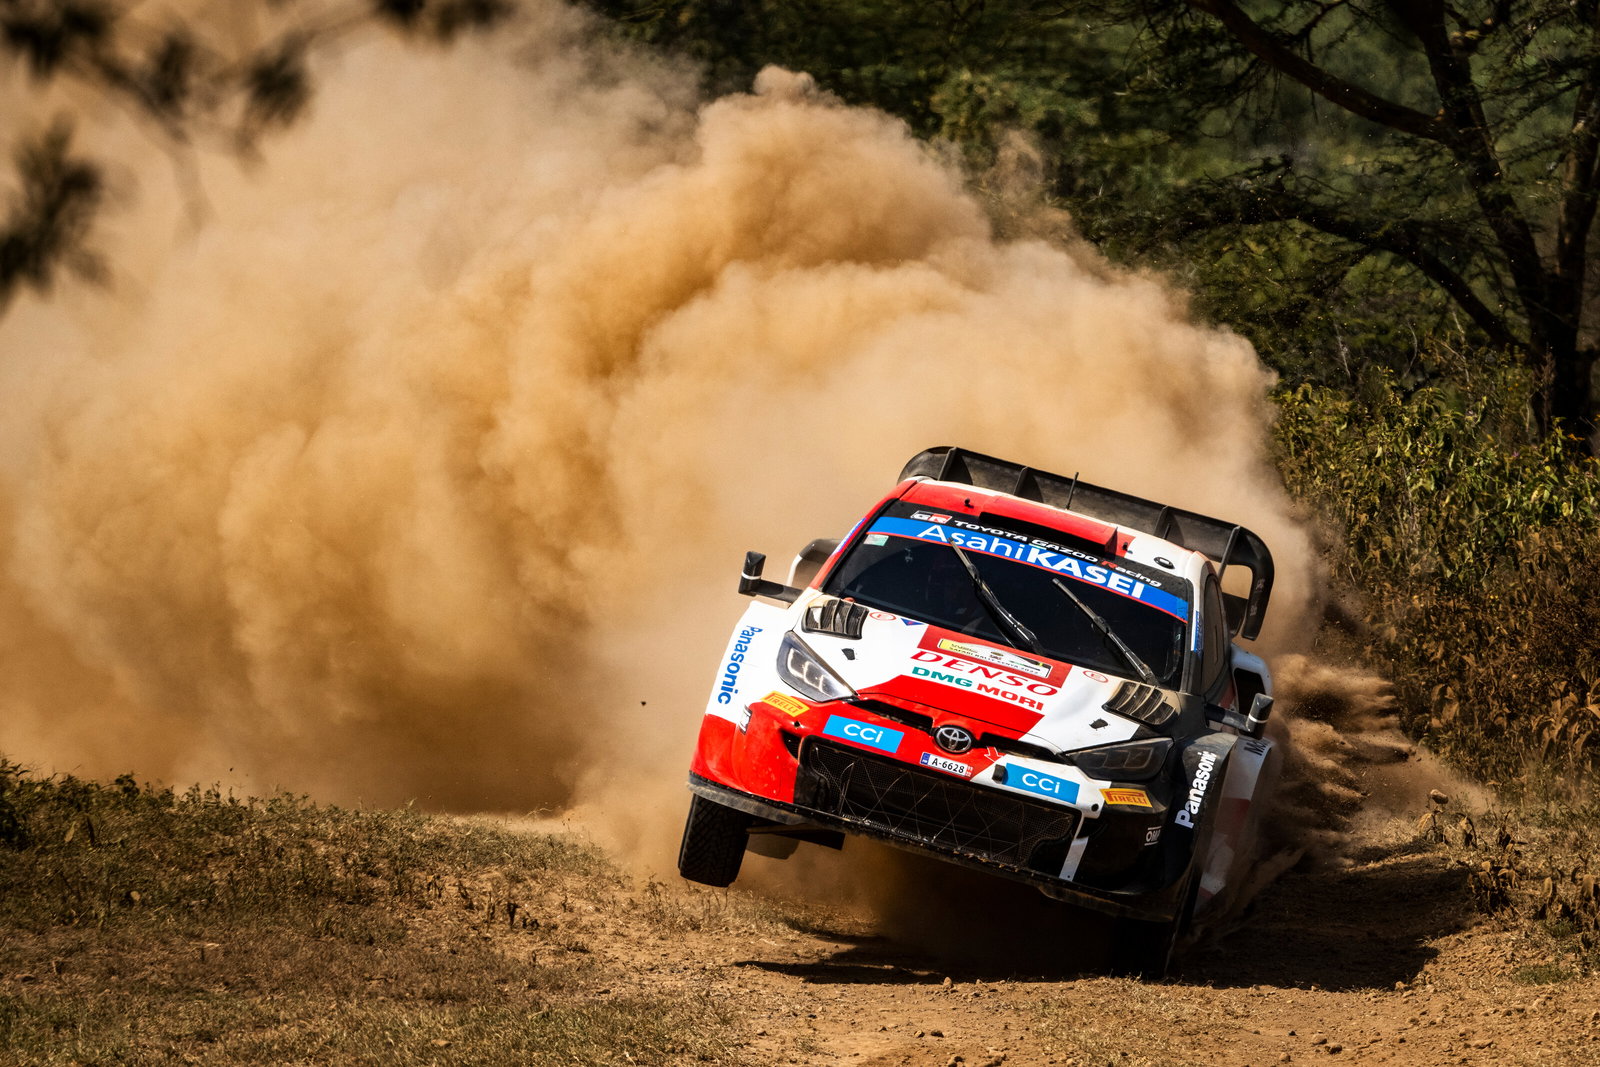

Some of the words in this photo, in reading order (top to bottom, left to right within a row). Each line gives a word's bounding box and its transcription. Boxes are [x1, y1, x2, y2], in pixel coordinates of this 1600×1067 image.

[910, 510, 952, 524] GR
[954, 520, 1028, 542] TOYOTA
[1032, 539, 1098, 563] GAZOO
[1102, 559, 1162, 587] Racing
[717, 625, 763, 704] Panasonic
[910, 650, 1058, 696] DENSO
[764, 692, 804, 714] PIRELLI
[912, 666, 973, 687] DMG
[976, 682, 1045, 711] MORI
[931, 758, 966, 774] A-6628
[1105, 790, 1147, 805] PIRELLI
